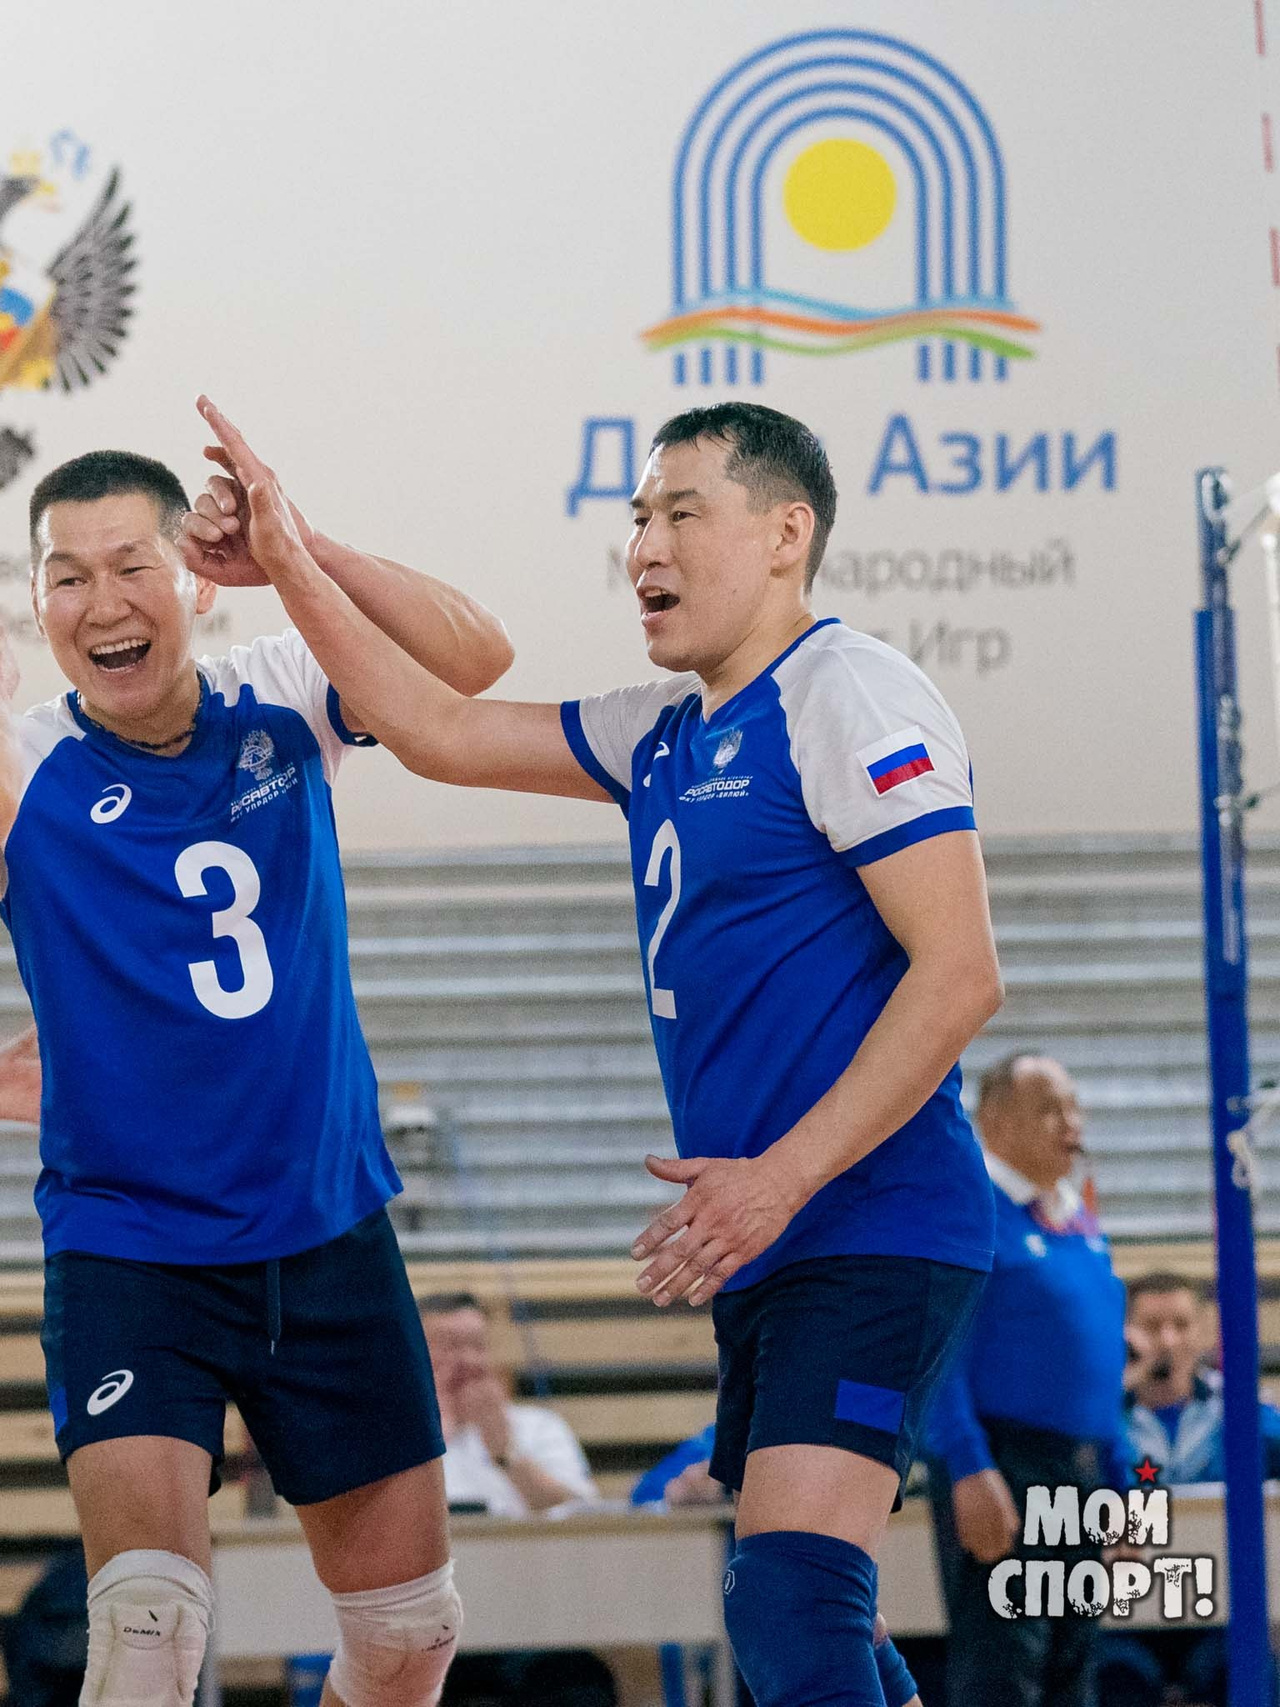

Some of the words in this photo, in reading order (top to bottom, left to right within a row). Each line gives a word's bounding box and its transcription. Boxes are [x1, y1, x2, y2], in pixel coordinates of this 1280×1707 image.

[868, 412, 1119, 496] Азии
[909, 617, 1012, 679] Игр
[174, 840, 273, 1019] 3
[643, 818, 680, 1019] 2
